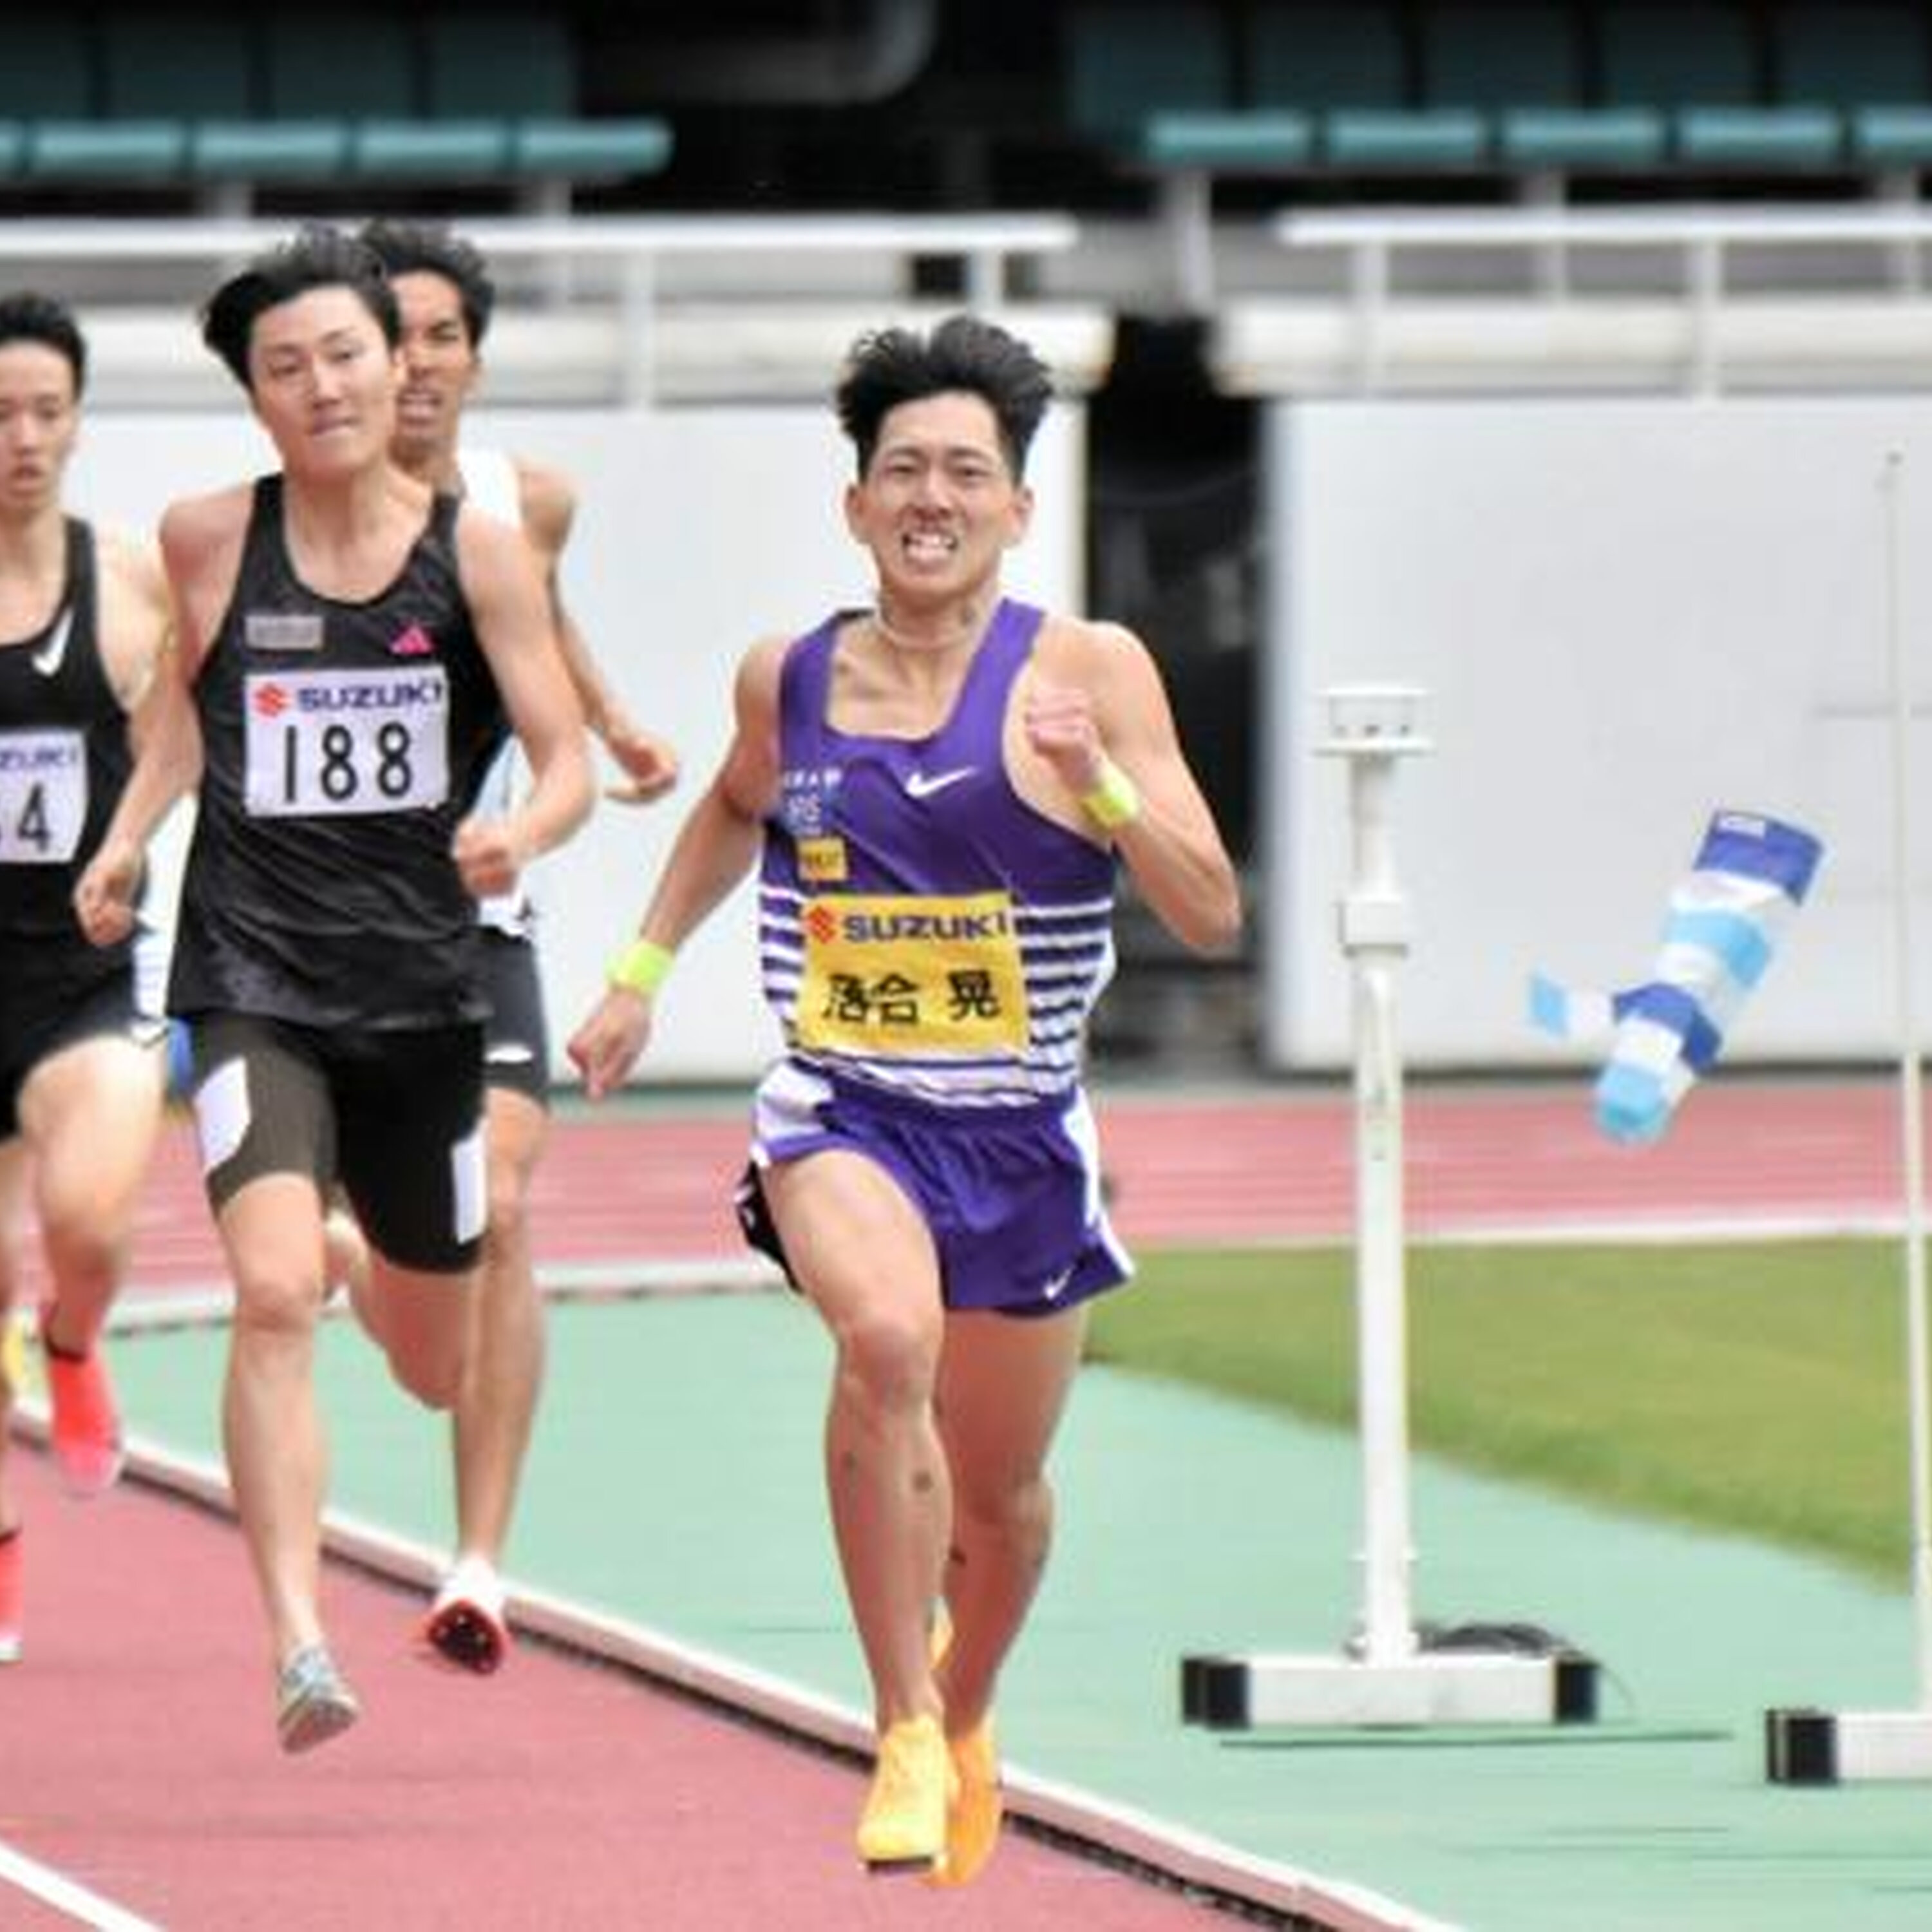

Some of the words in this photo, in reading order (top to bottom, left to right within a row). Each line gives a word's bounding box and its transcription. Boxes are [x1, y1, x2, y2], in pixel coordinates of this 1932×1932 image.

[298, 677, 442, 712] SUZUKI
[286, 721, 412, 804] 188
[0, 781, 50, 854] 4
[845, 913, 1007, 941] SUZUKI
